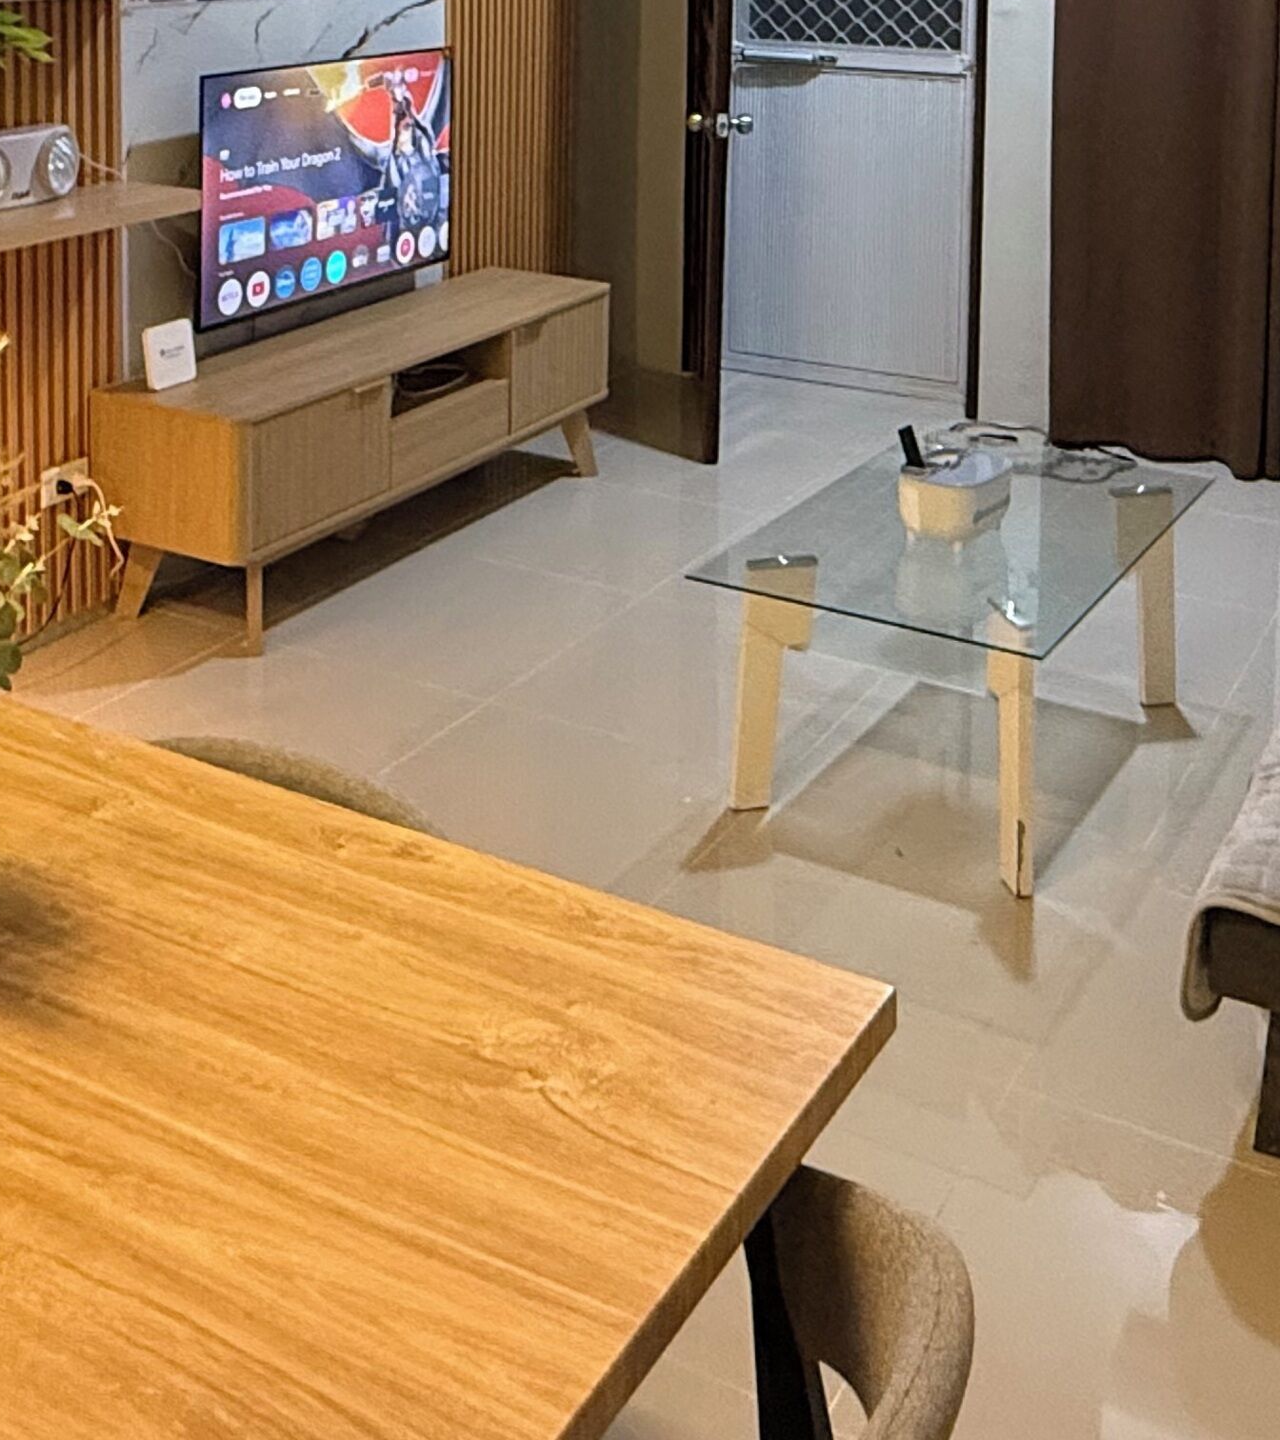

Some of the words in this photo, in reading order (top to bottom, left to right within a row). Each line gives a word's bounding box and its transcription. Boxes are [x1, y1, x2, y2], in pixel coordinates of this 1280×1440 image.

[220, 168, 243, 183] How
[244, 165, 256, 178] to
[256, 160, 280, 176] Train
[280, 157, 300, 171] Your
[302, 152, 334, 168] Dragon
